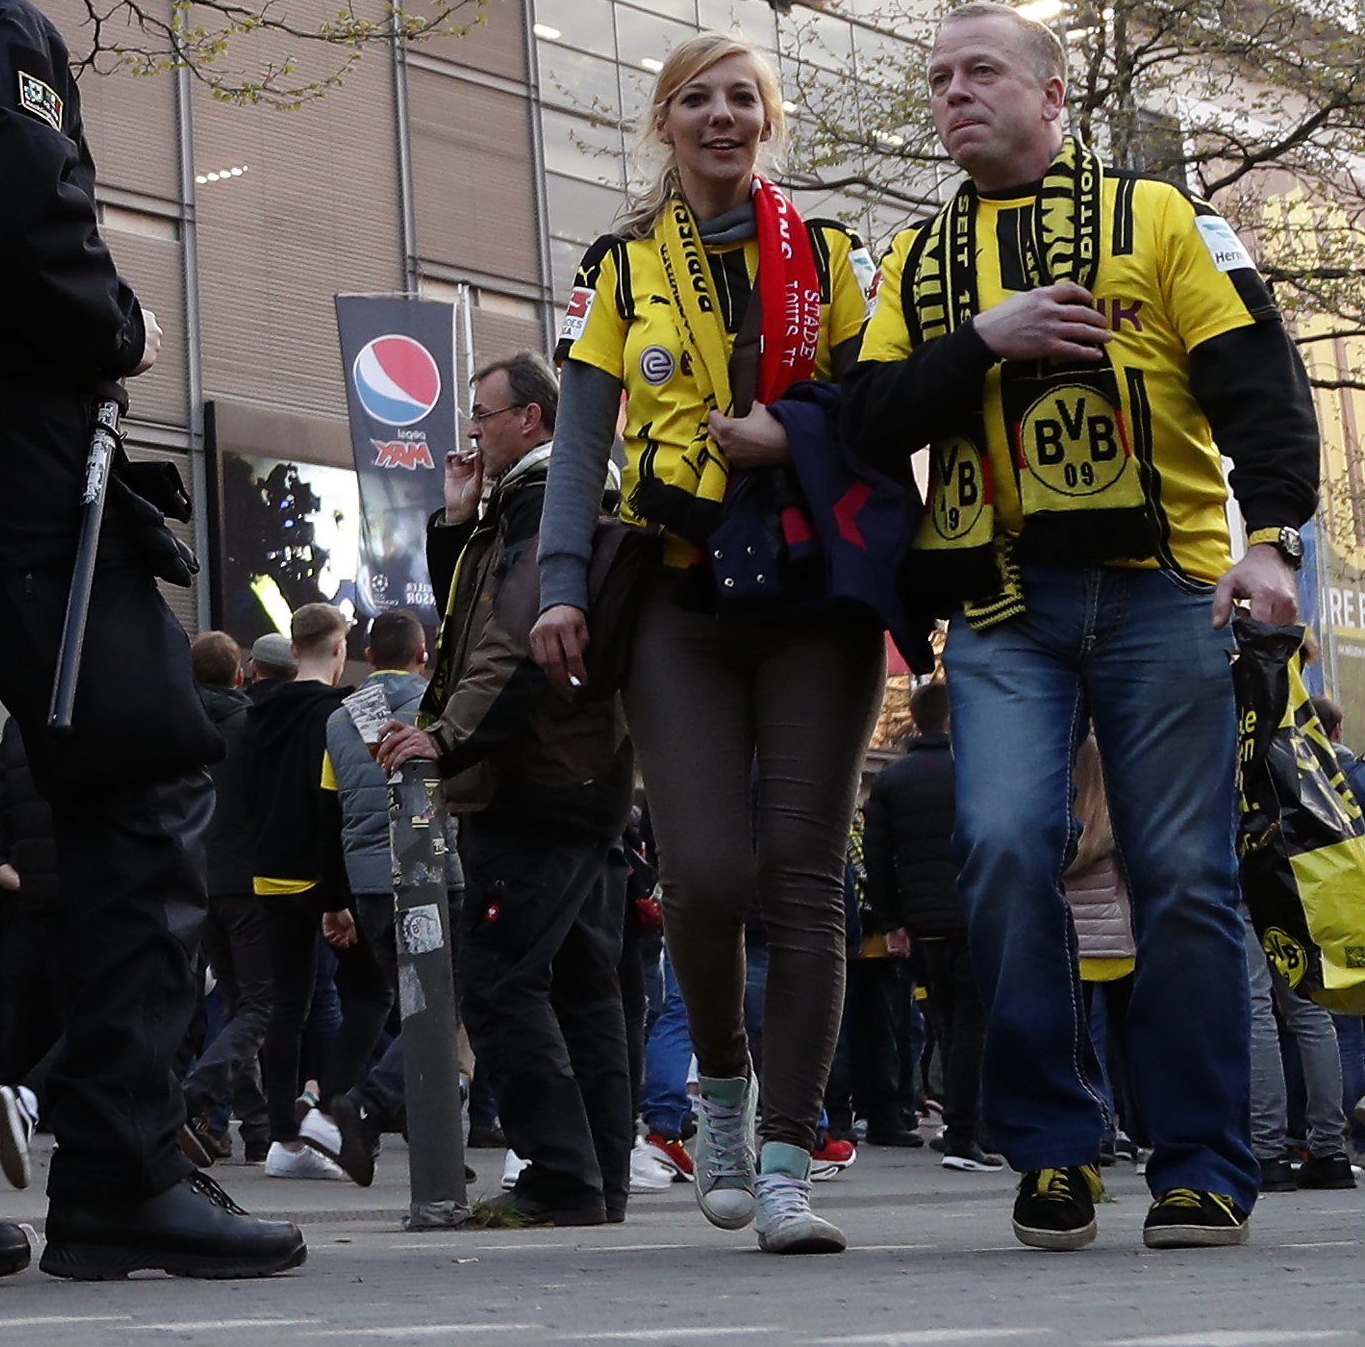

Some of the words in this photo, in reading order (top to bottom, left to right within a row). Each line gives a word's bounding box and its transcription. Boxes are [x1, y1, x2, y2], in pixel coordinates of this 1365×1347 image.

[956, 194, 969, 268] SEIT
[800, 289, 822, 361] STADE
[1034, 398, 1118, 466] BVB
[936, 445, 978, 507] VB
[1064, 461, 1094, 488] 09
